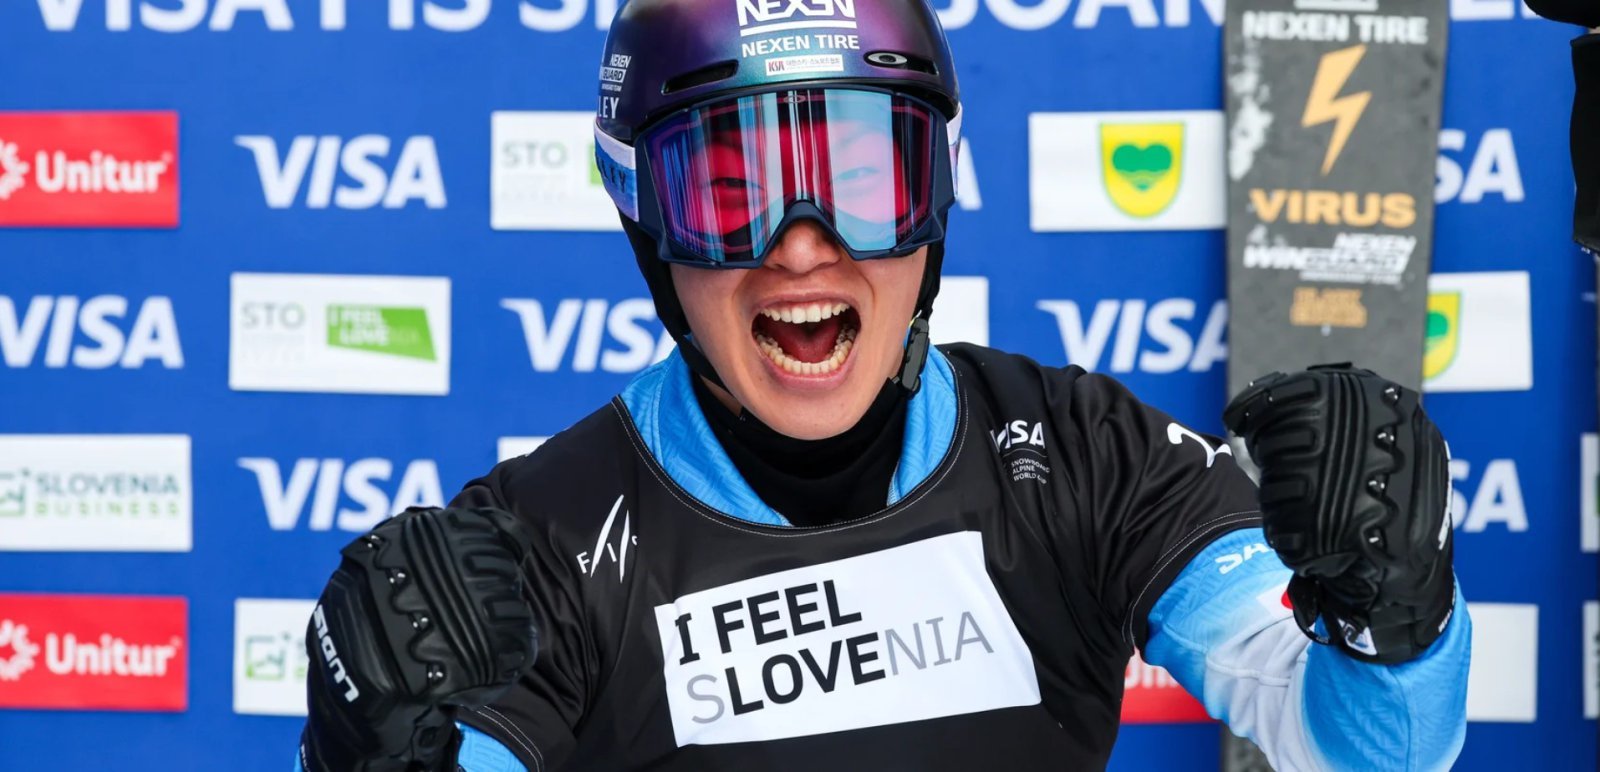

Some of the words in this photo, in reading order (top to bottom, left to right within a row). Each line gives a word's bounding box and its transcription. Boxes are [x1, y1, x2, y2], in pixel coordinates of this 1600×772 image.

[1242, 10, 1350, 42] NEXEN
[1354, 15, 1429, 44] TIRE
[741, 34, 811, 58] NEXEN
[814, 34, 860, 50] TIRE
[598, 96, 620, 119] LEY
[35, 149, 167, 193] Unitur
[236, 135, 447, 209] VISA
[502, 140, 568, 168] STO
[1433, 128, 1526, 204] SA
[1250, 189, 1417, 228] VIRUS
[0, 295, 184, 369] VISA
[240, 302, 305, 329] STO
[36, 472, 180, 497] SLOVENIA
[1012, 465, 1036, 475] ALPINE
[1013, 472, 1036, 481] WORLD
[35, 500, 179, 517] BUSINESS
[237, 457, 446, 532] VISA
[675, 612, 700, 665] I
[712, 579, 863, 654] FEEL
[45, 634, 176, 677] Unitur
[686, 611, 995, 724] SLOVENIA
